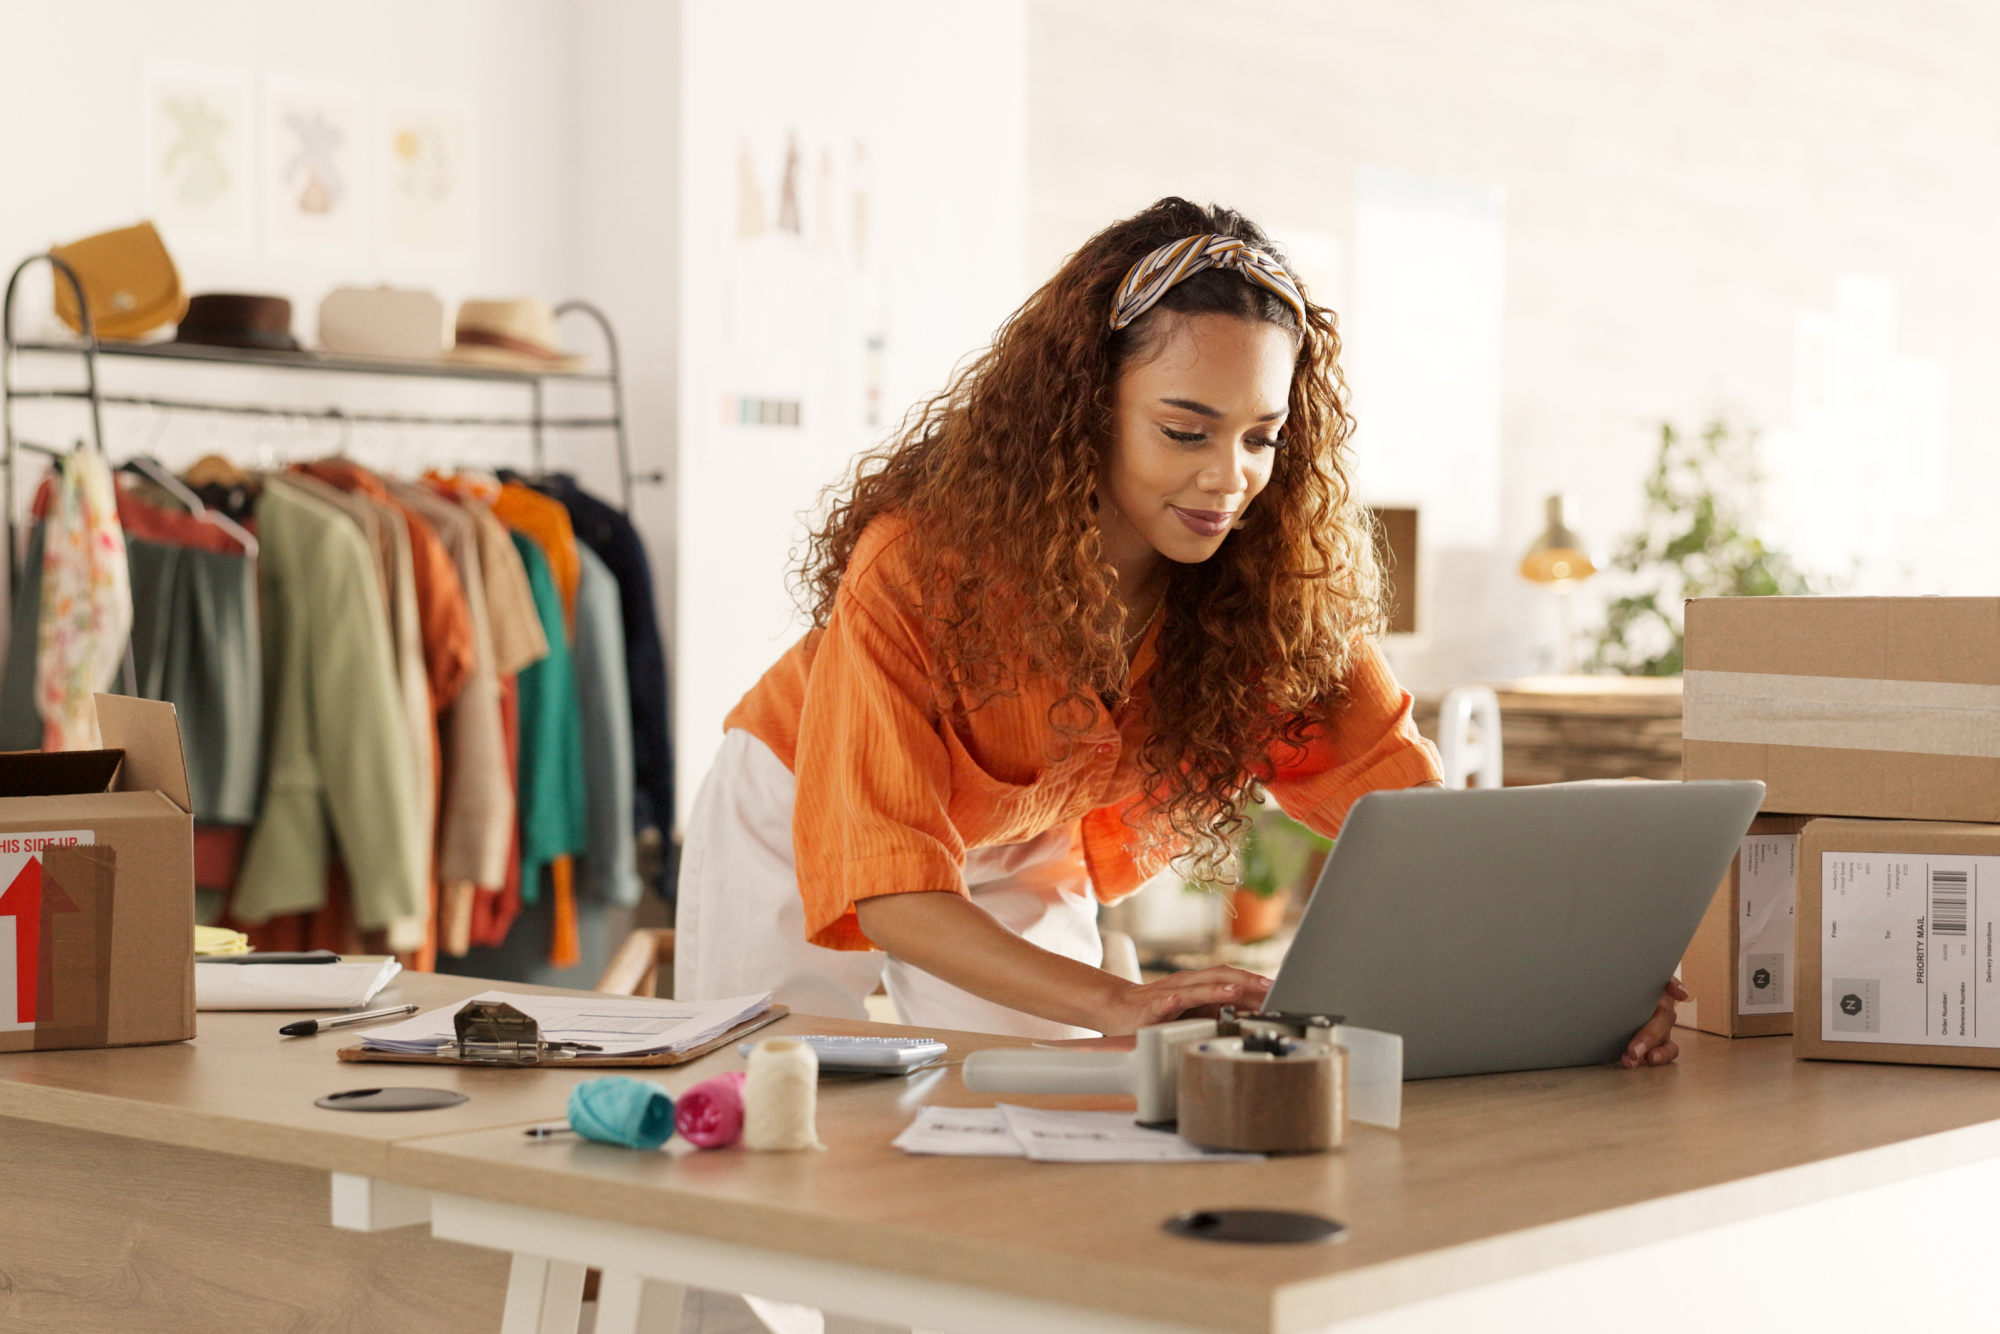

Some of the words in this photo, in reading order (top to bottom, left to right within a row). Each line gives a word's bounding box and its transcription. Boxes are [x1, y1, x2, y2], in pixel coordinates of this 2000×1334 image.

[23, 837, 55, 853] SIDE
[58, 836, 78, 851] UP
[1857, 862, 1862, 870] CT
[1916, 916, 1925, 939] MAIL
[1916, 941, 1925, 984] PRIORITY
[1756, 974, 1766, 984] N
[1845, 999, 1856, 1010] N
